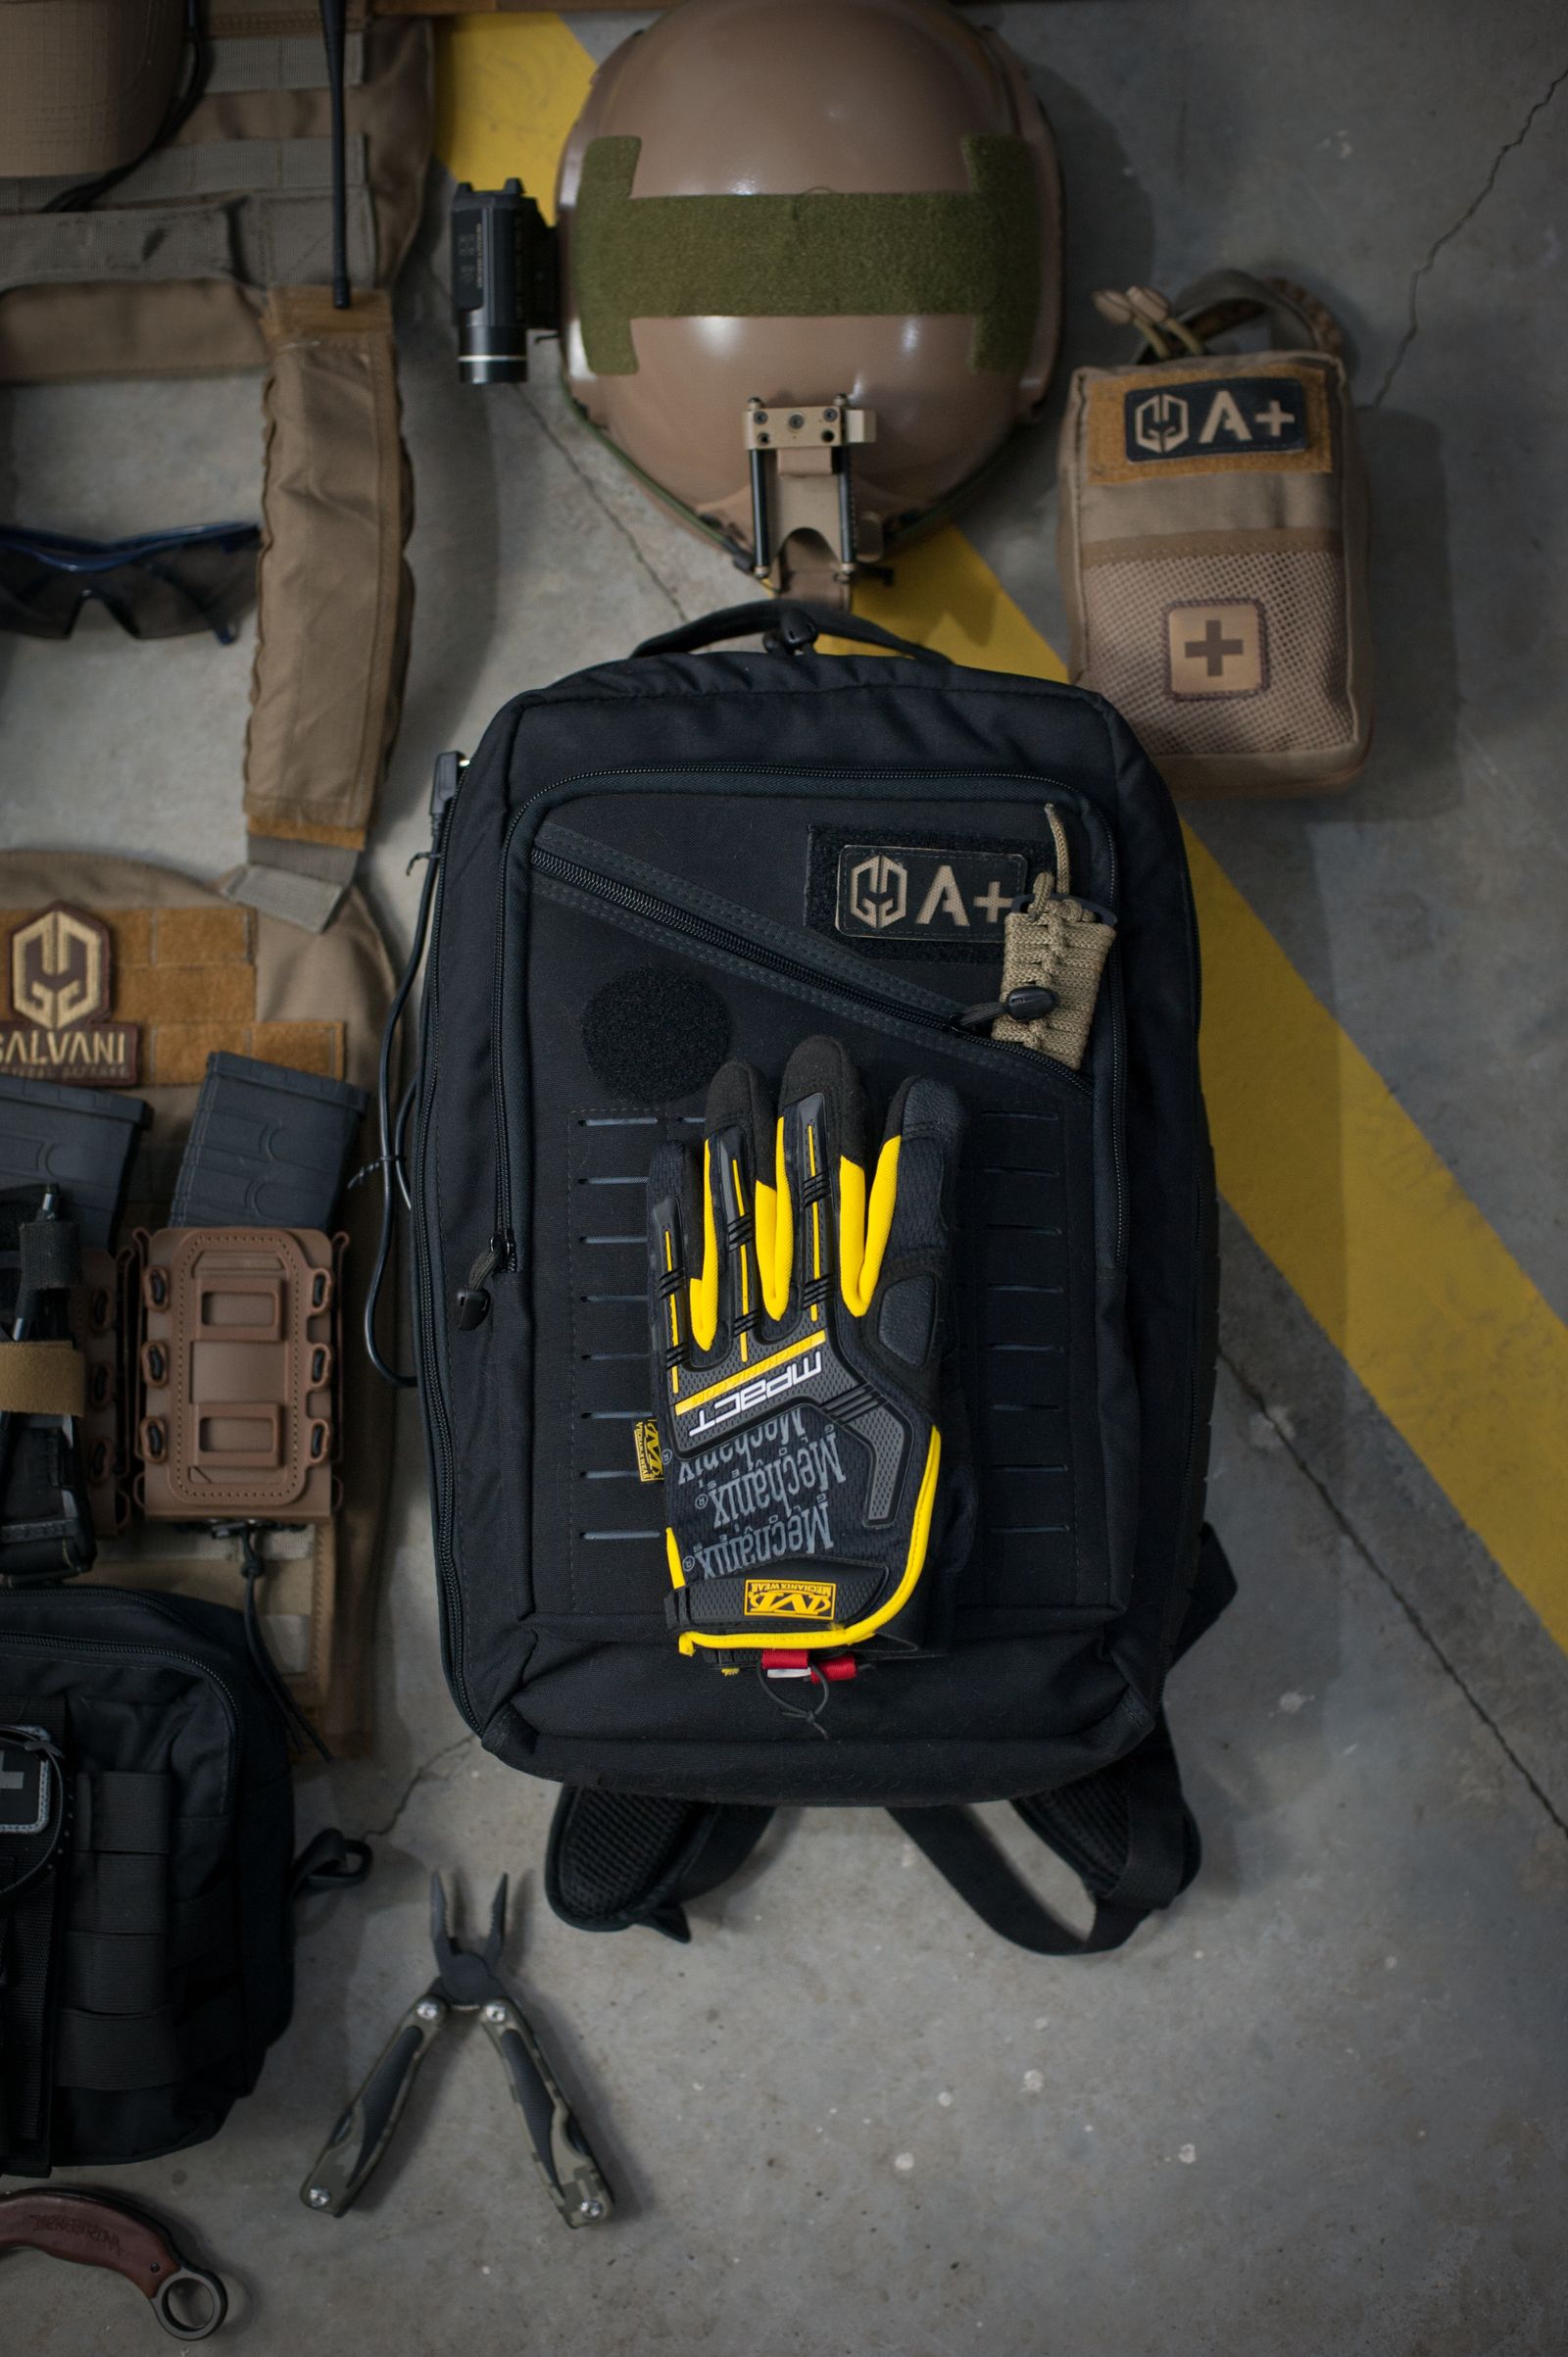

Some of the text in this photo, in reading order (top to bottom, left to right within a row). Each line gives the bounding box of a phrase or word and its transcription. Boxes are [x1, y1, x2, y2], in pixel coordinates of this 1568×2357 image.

[708, 1432, 847, 1530] Mechanix
[751, 1582, 832, 1596] MECHANIX WEAR
